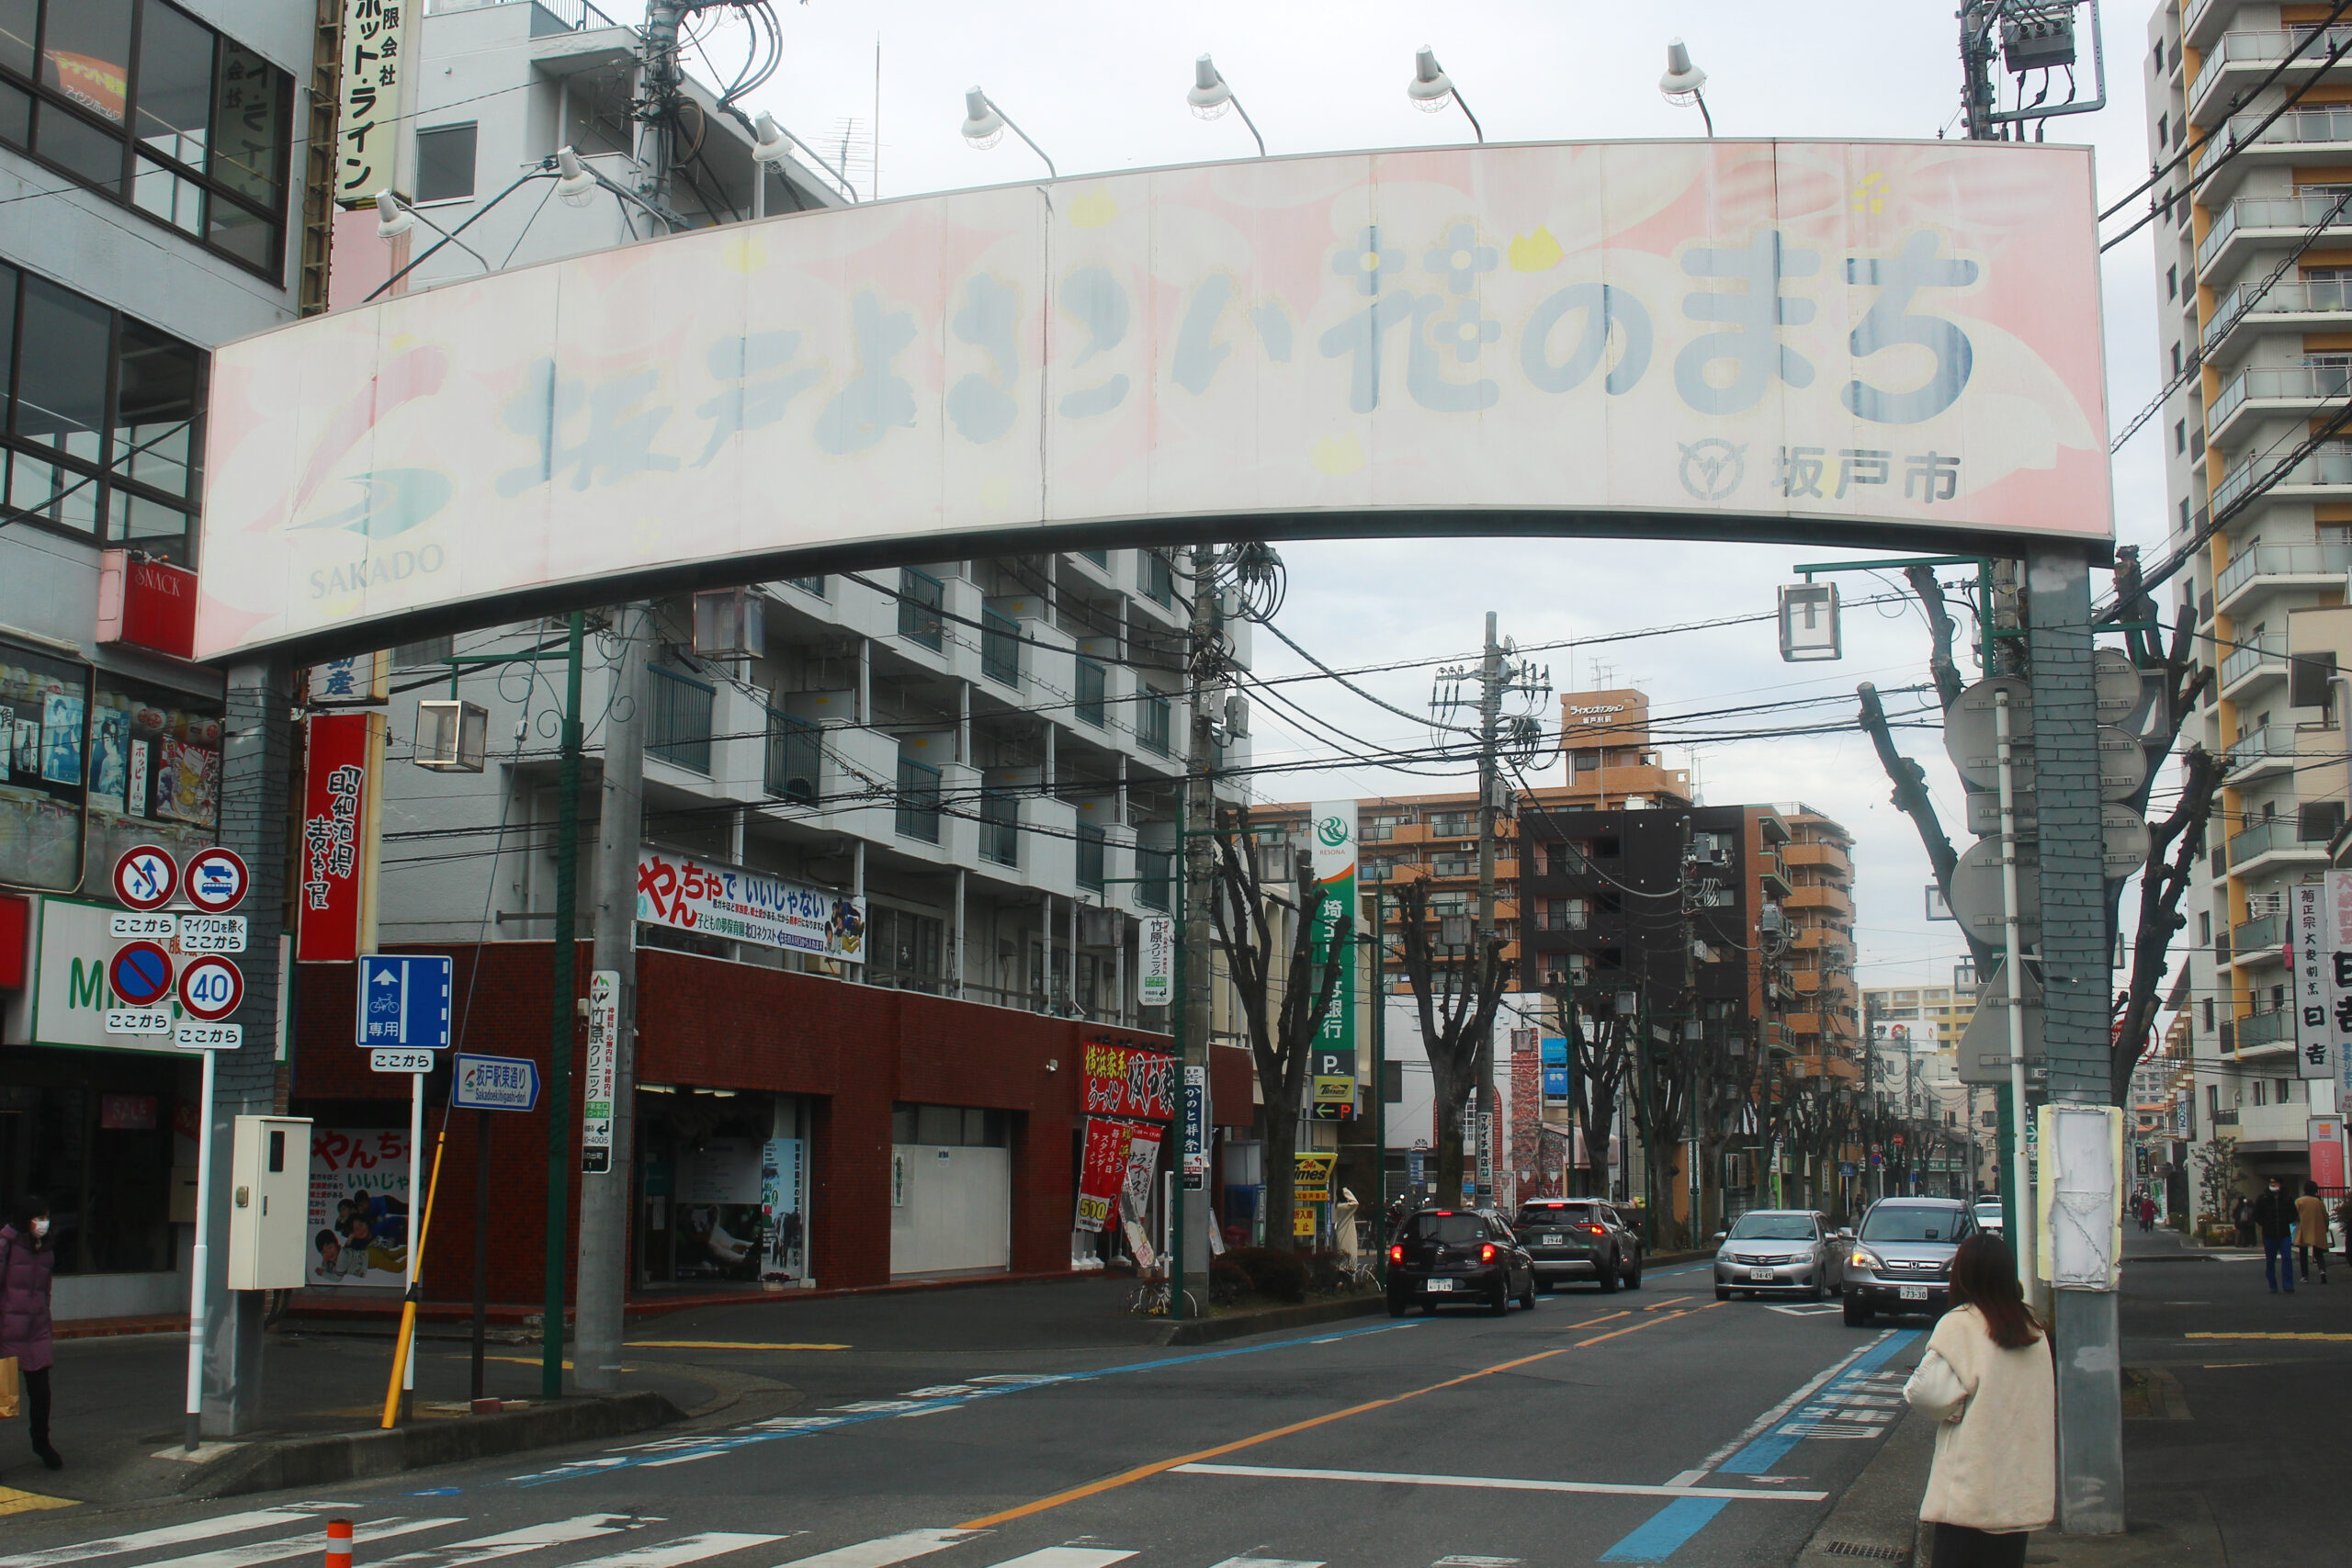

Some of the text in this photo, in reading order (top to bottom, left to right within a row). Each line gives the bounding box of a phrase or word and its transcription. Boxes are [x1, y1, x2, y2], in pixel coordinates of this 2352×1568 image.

[379, 0, 399, 86] 限会社
[1772, 446, 1962, 503] 坂戸市
[134, 566, 181, 598] SNACK
[310, 543, 445, 601] SAKADO
[134, 746, 145, 793] ホッピー
[327, 765, 364, 878] 昭和酒場
[745, 876, 825, 919] いいじゃない
[114, 919, 173, 933] ここから
[184, 919, 243, 933] マイクロを除く
[186, 935, 242, 950] ここから
[1150, 920, 1162, 976] 竹原クリニック
[192, 974, 229, 1002] 40
[109, 1014, 167, 1028] ここから
[368, 1021, 399, 1037] 専用
[179, 1029, 238, 1043] ここから
[2302, 1006, 2326, 1066] 日吉
[375, 1055, 430, 1068] ここから
[588, 1007, 605, 1100] 竹原クリニック
[1085, 1044, 1127, 1079] 横浜家系
[1323, 1055, 1338, 1074] P
[476, 1063, 526, 1089] 坂戸駅東通り
[1088, 1078, 1125, 1112] ラーメン
[1340, 1104, 1351, 1119] P
[2178, 1100, 2187, 1128] SECOM
[1295, 1167, 1327, 1180] imes
[1080, 1199, 1106, 1221] 500
[1905, 1290, 1927, 1299] 73-30
